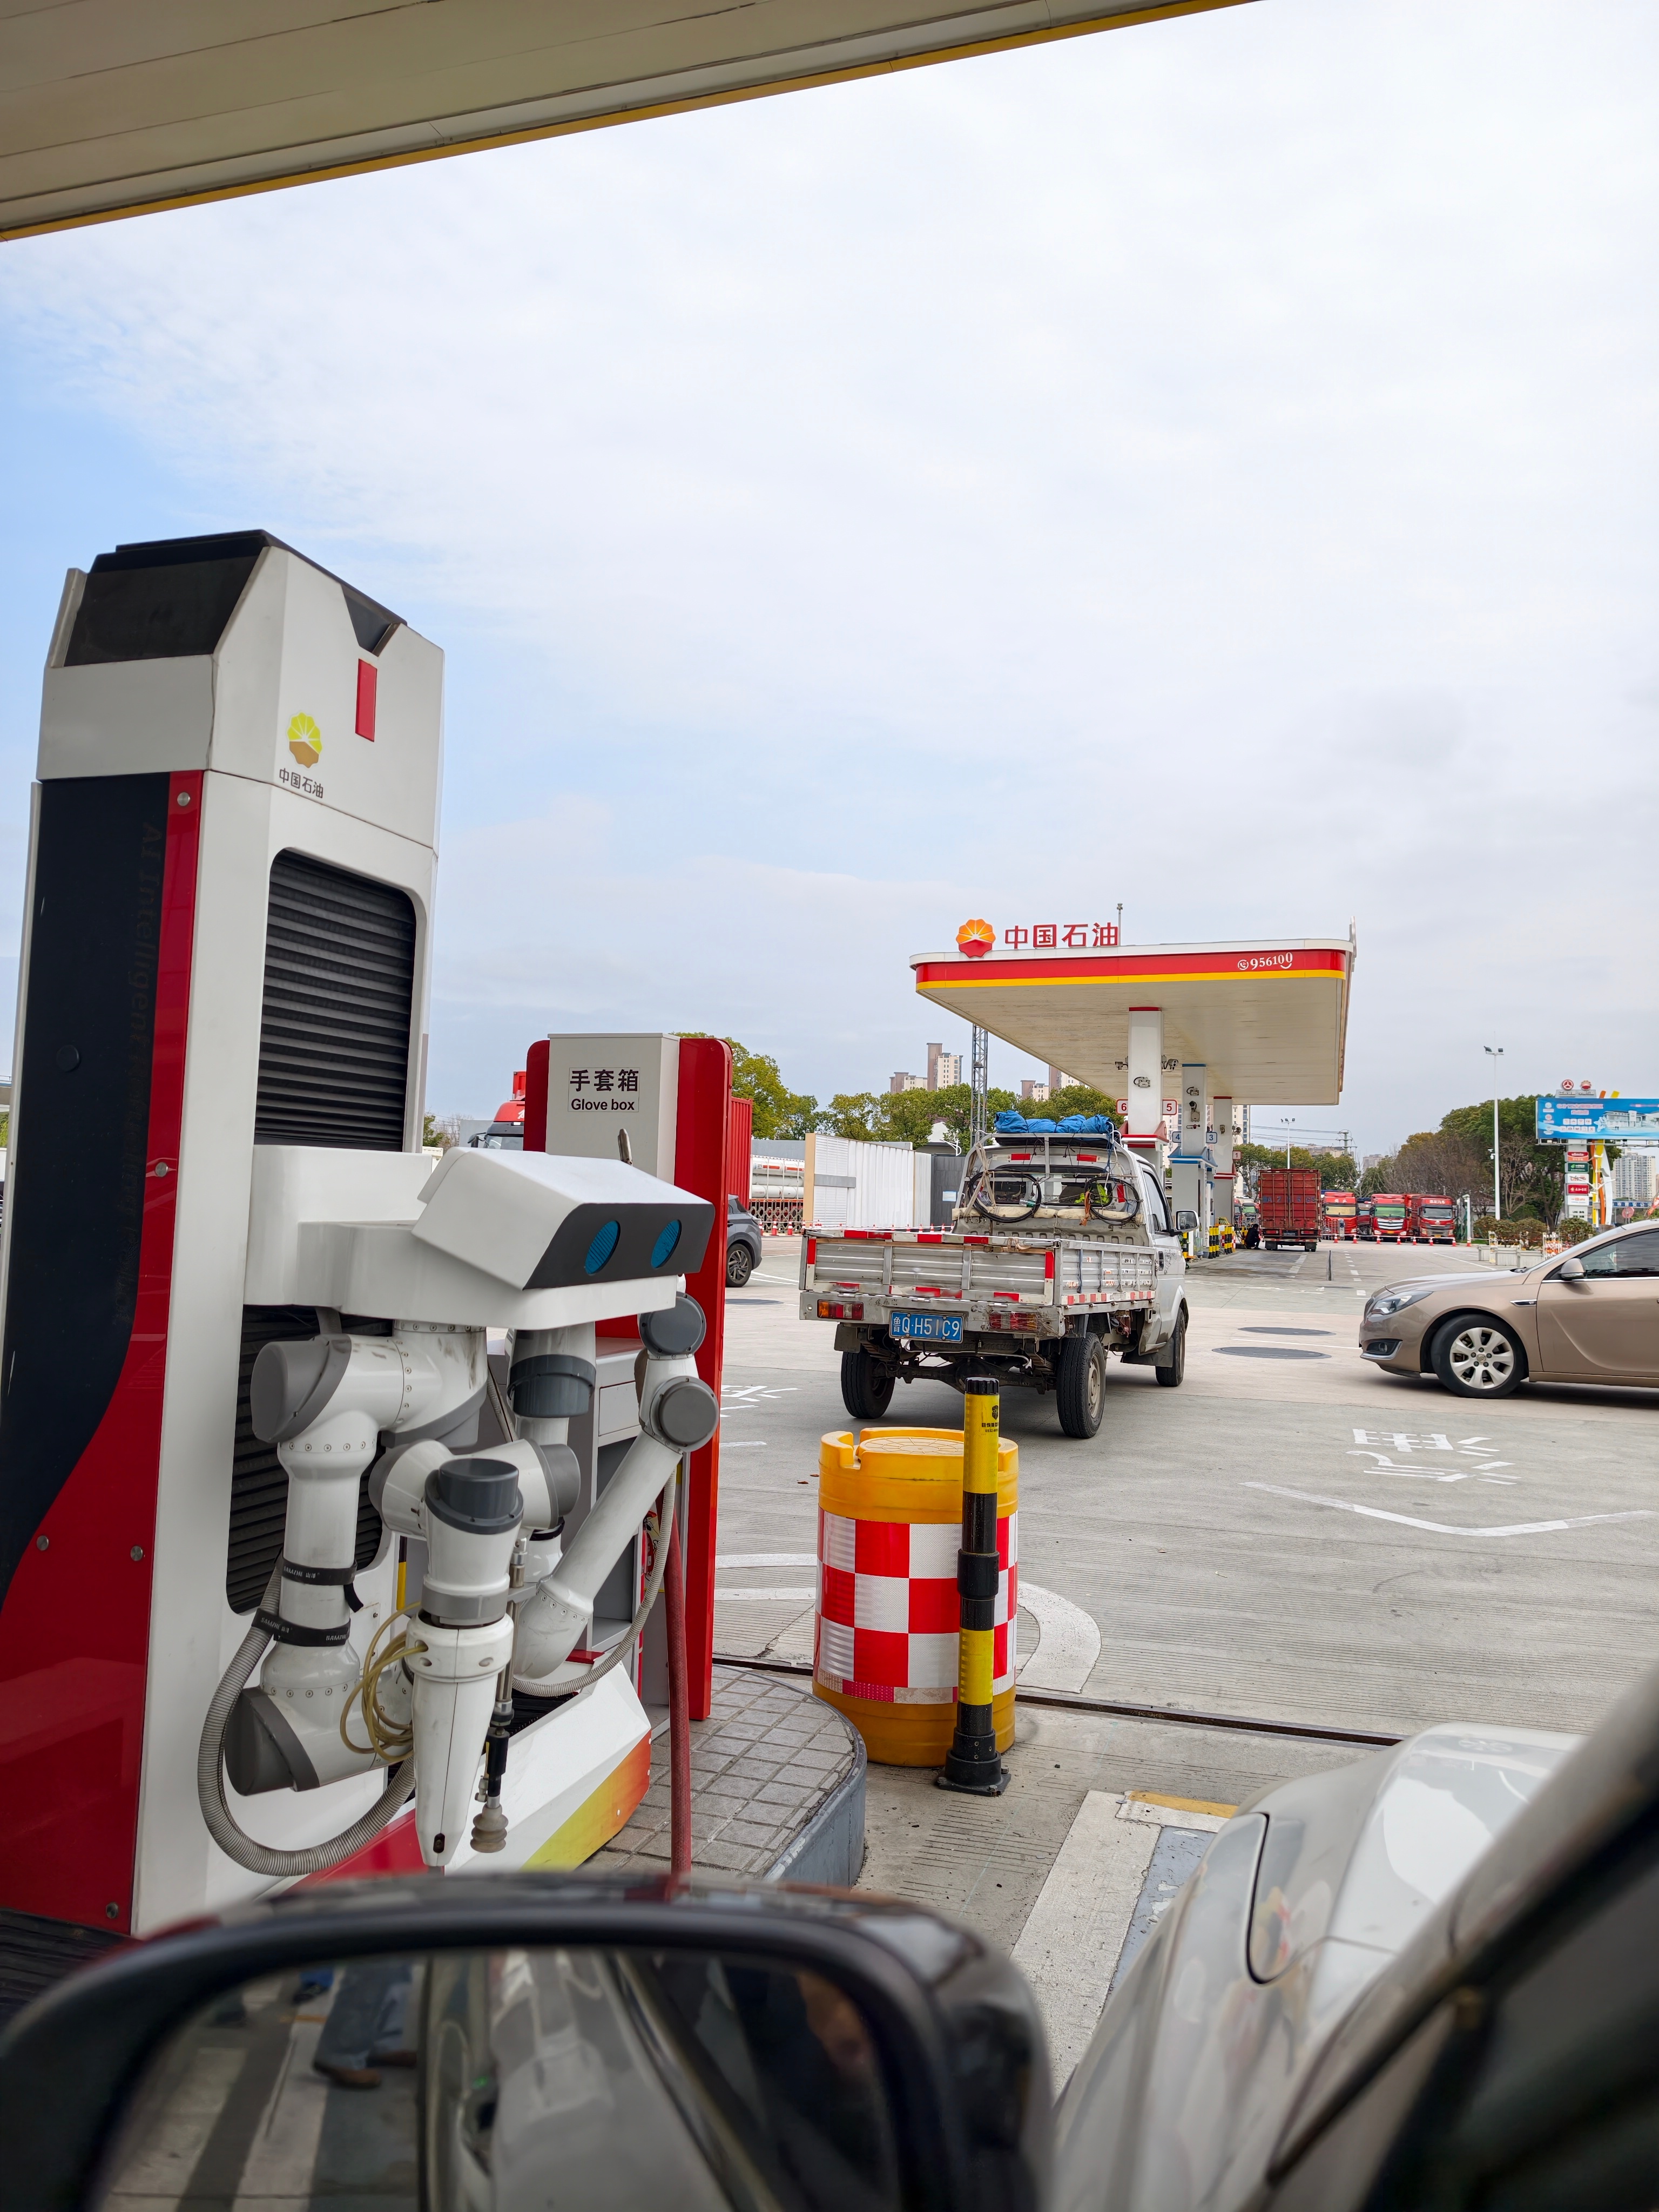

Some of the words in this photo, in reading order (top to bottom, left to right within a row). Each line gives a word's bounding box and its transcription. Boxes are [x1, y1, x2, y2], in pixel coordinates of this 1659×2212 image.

[279, 767, 323, 799] 中国石油
[1004, 922, 1118, 949] 中国石油
[1250, 952, 1293, 970] 956100
[570, 1069, 639, 1092] 手套箱
[571, 1098, 608, 1110] Glove
[611, 1098, 635, 1110] box
[1121, 1103, 1127, 1111] 6
[1166, 1103, 1172, 1111] 5
